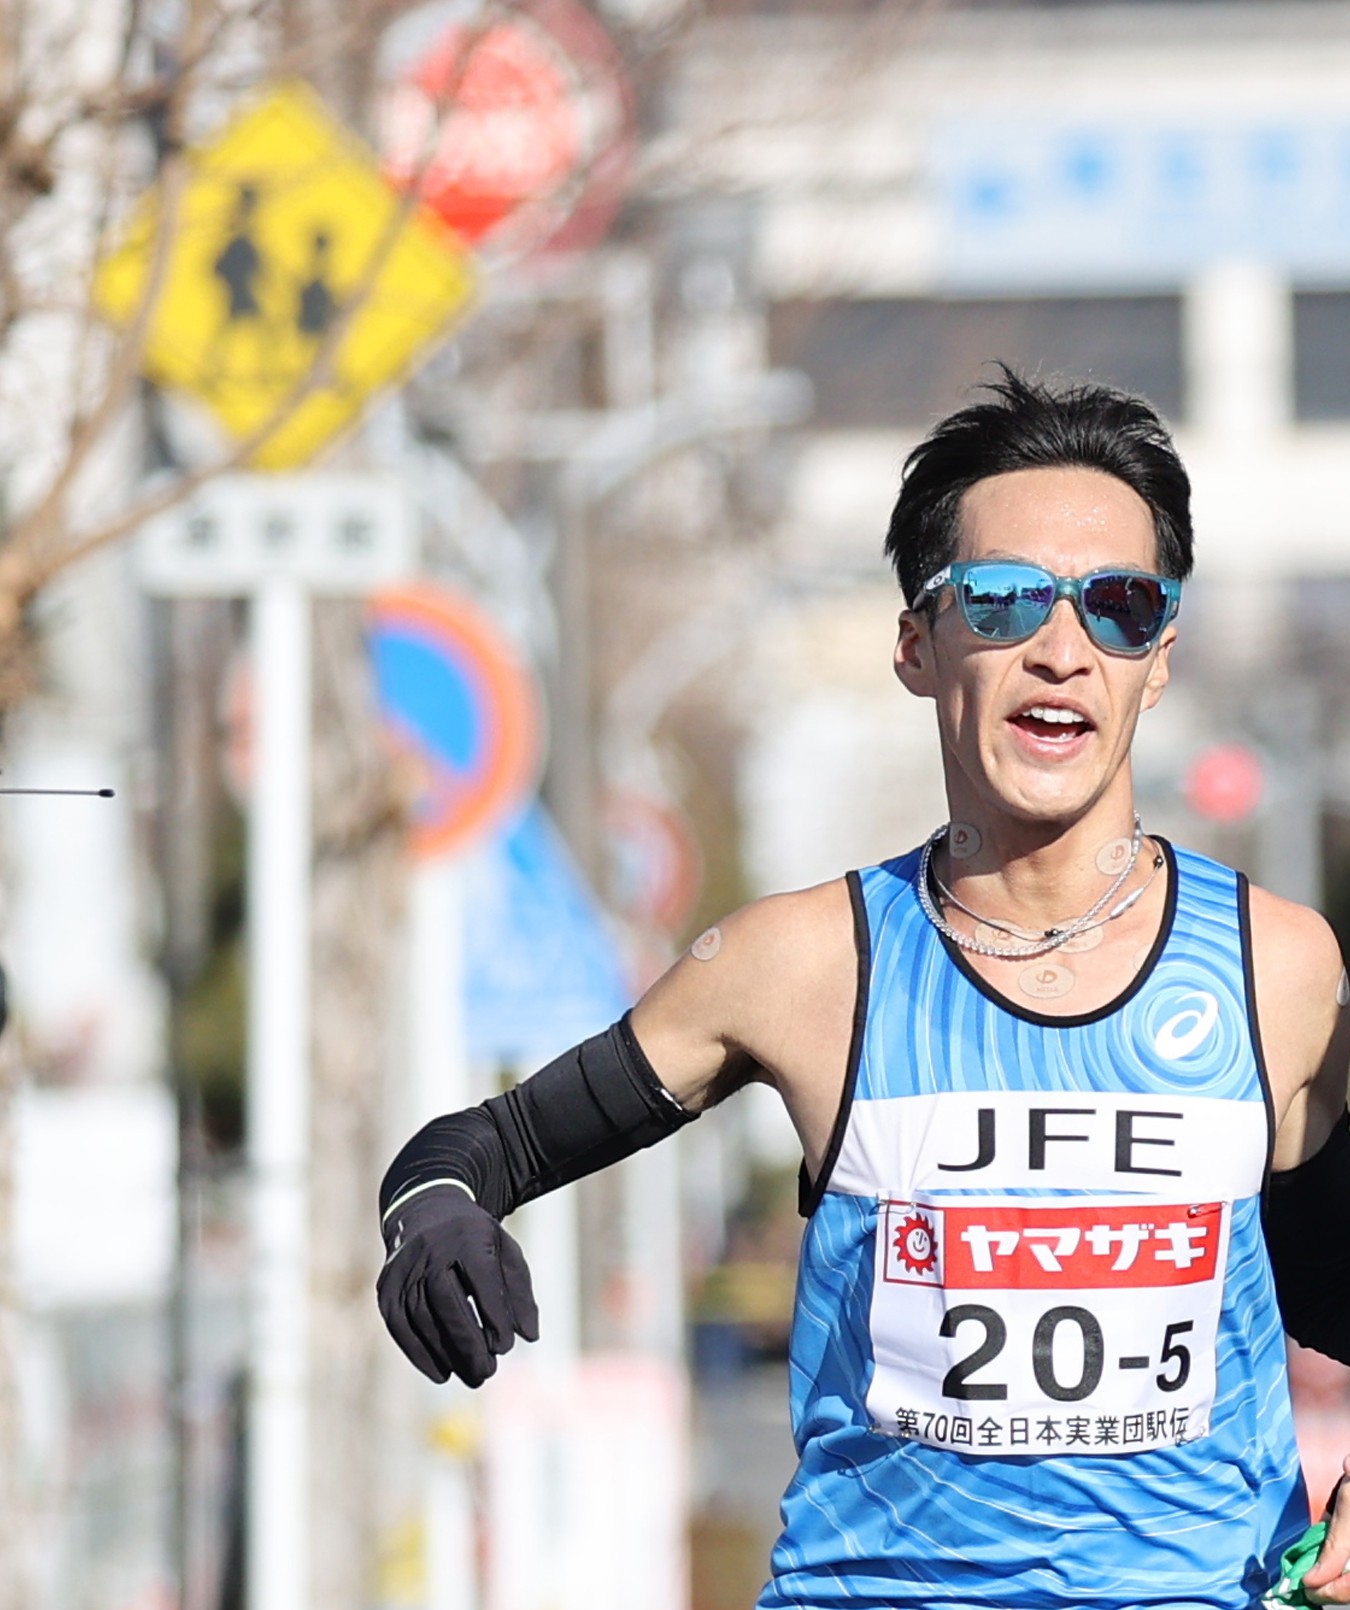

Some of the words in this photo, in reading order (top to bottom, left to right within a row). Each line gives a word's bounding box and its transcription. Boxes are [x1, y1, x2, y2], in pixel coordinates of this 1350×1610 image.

[937, 1107, 1184, 1177] JFE
[960, 1222, 1208, 1273] ヤマザキ
[938, 1303, 1194, 1403] 20-5
[895, 1406, 1191, 1447] 第70回全日本実業団駅伝
